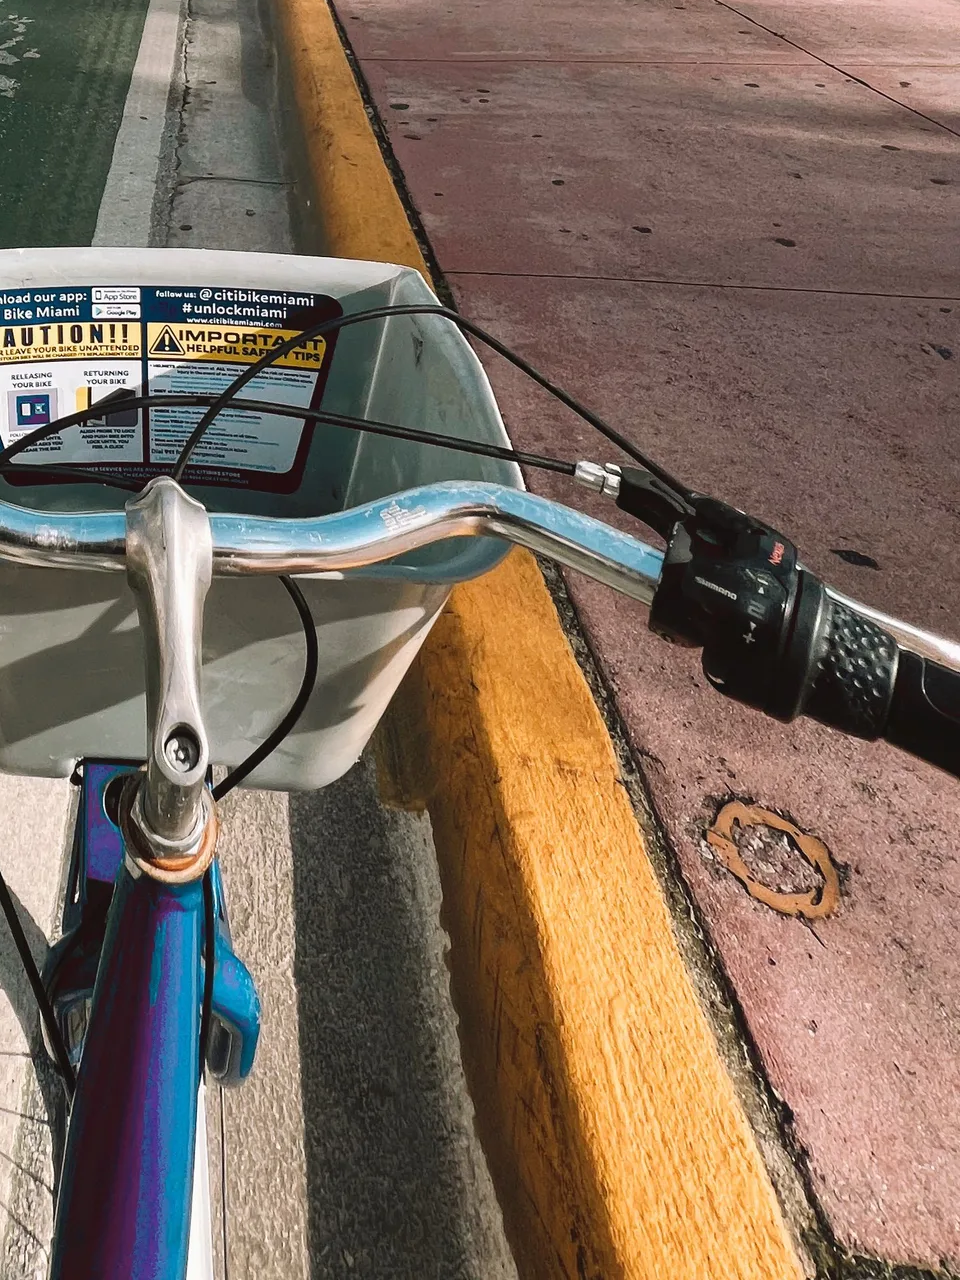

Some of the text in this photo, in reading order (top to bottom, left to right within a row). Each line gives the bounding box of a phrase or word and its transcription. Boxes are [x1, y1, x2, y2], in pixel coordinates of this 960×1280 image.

[34, 294, 56, 302] our
[59, 293, 87, 303] app:
[155, 290, 183, 298] follow
[4, 307, 33, 320] Bike
[36, 305, 80, 319] Miami
[106, 309, 137, 317] Google Play
[182, 302, 287, 319] #unlockmiami
[186, 317, 283, 328] www.citibikemiami.com
[79, 344, 140, 352] UNATTENDED
[187, 344, 240, 355] HELPFUL
[292, 350, 320, 362] TIPS
[11, 372, 53, 380] RELEASING
